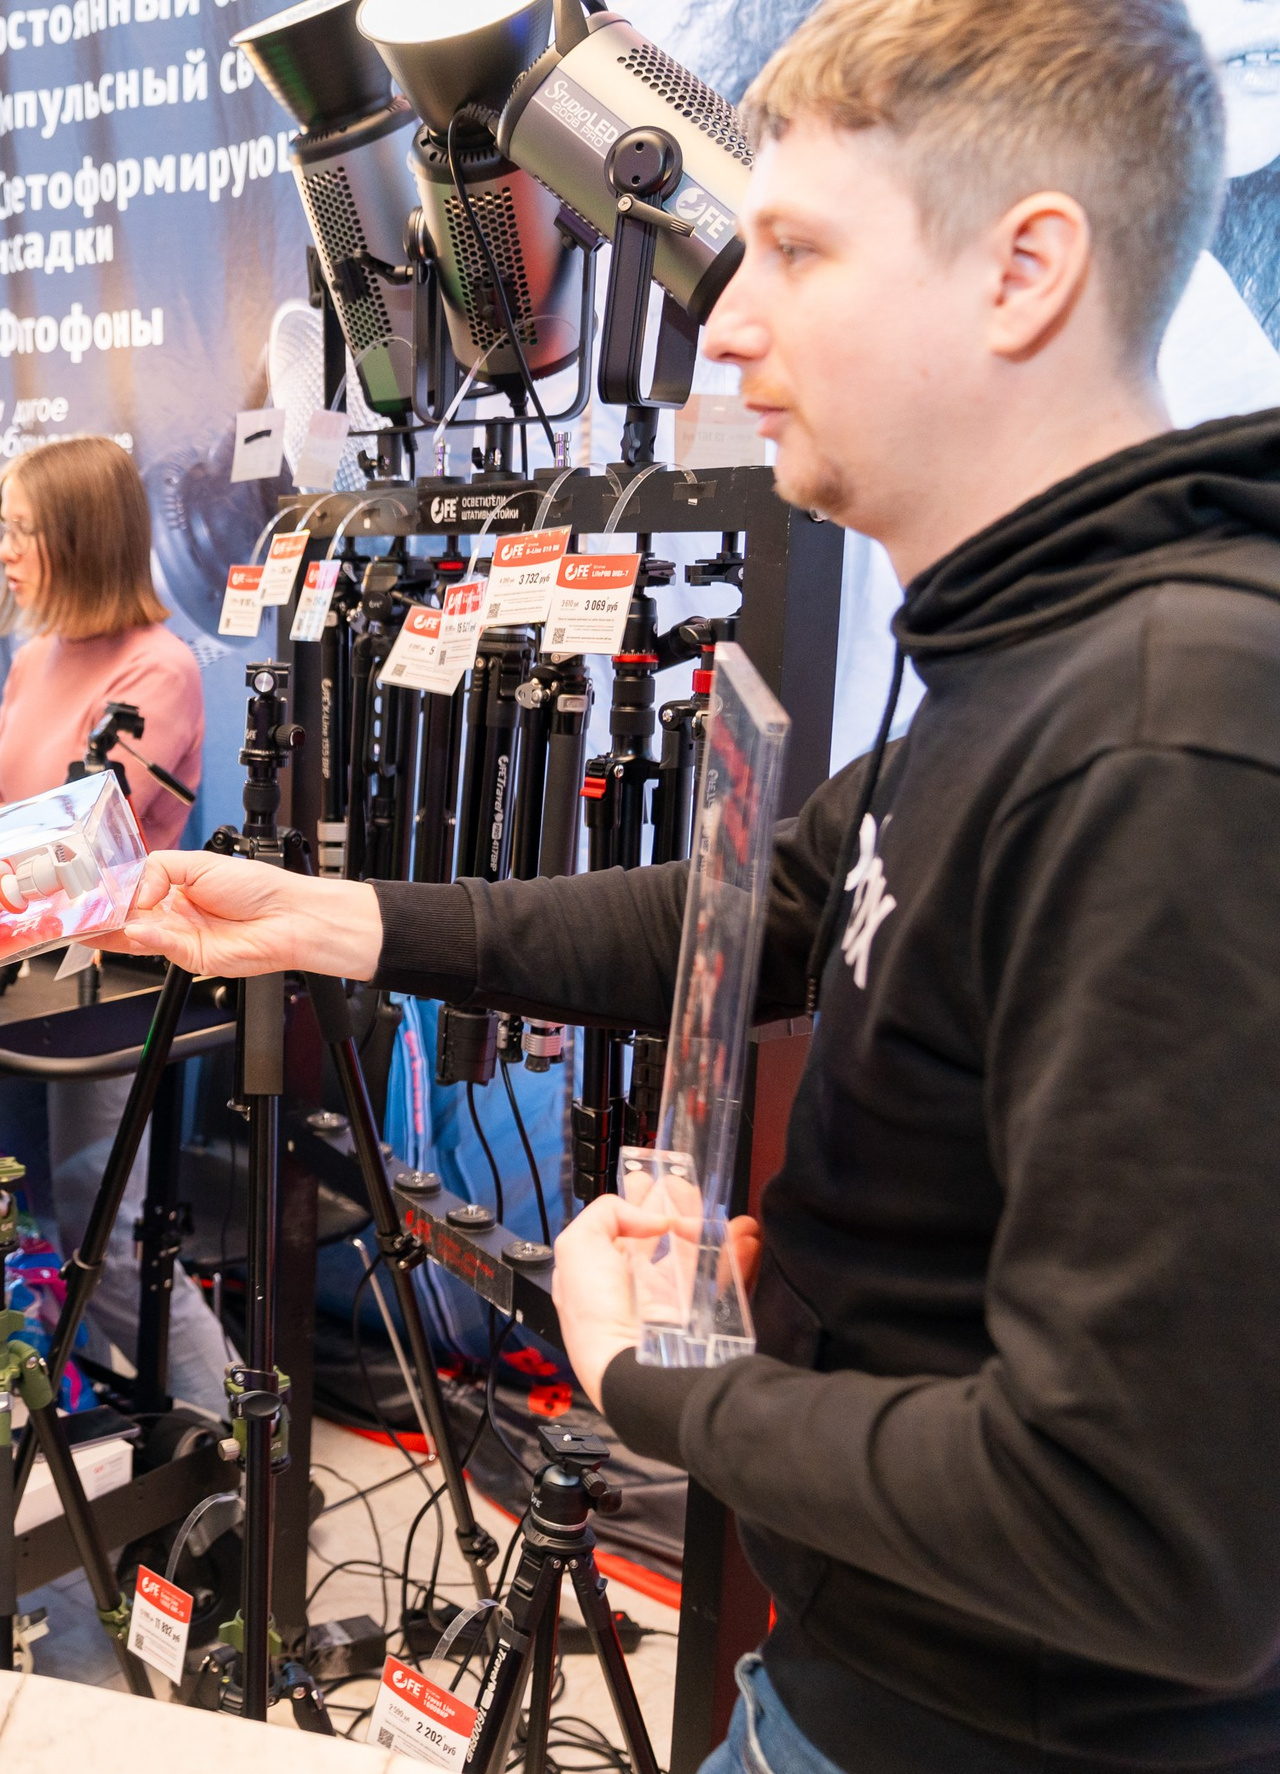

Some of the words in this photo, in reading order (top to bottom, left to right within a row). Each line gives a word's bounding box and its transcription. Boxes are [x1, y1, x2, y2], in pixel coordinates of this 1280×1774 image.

[219, 48, 257, 95] св
[581, 126, 604, 147] PRO
[518, 574, 525, 585] 3
[525, 573, 540, 585] 732
[584, 599, 590, 611] 3
[591, 599, 606, 611] 069
[606, 601, 619, 613] руб
[489, 1648, 508, 1686] Travel
[424, 1692, 443, 1708] Travel
[416, 1721, 424, 1734] 2
[424, 1727, 444, 1747] 202
[442, 1743, 457, 1757] руб
